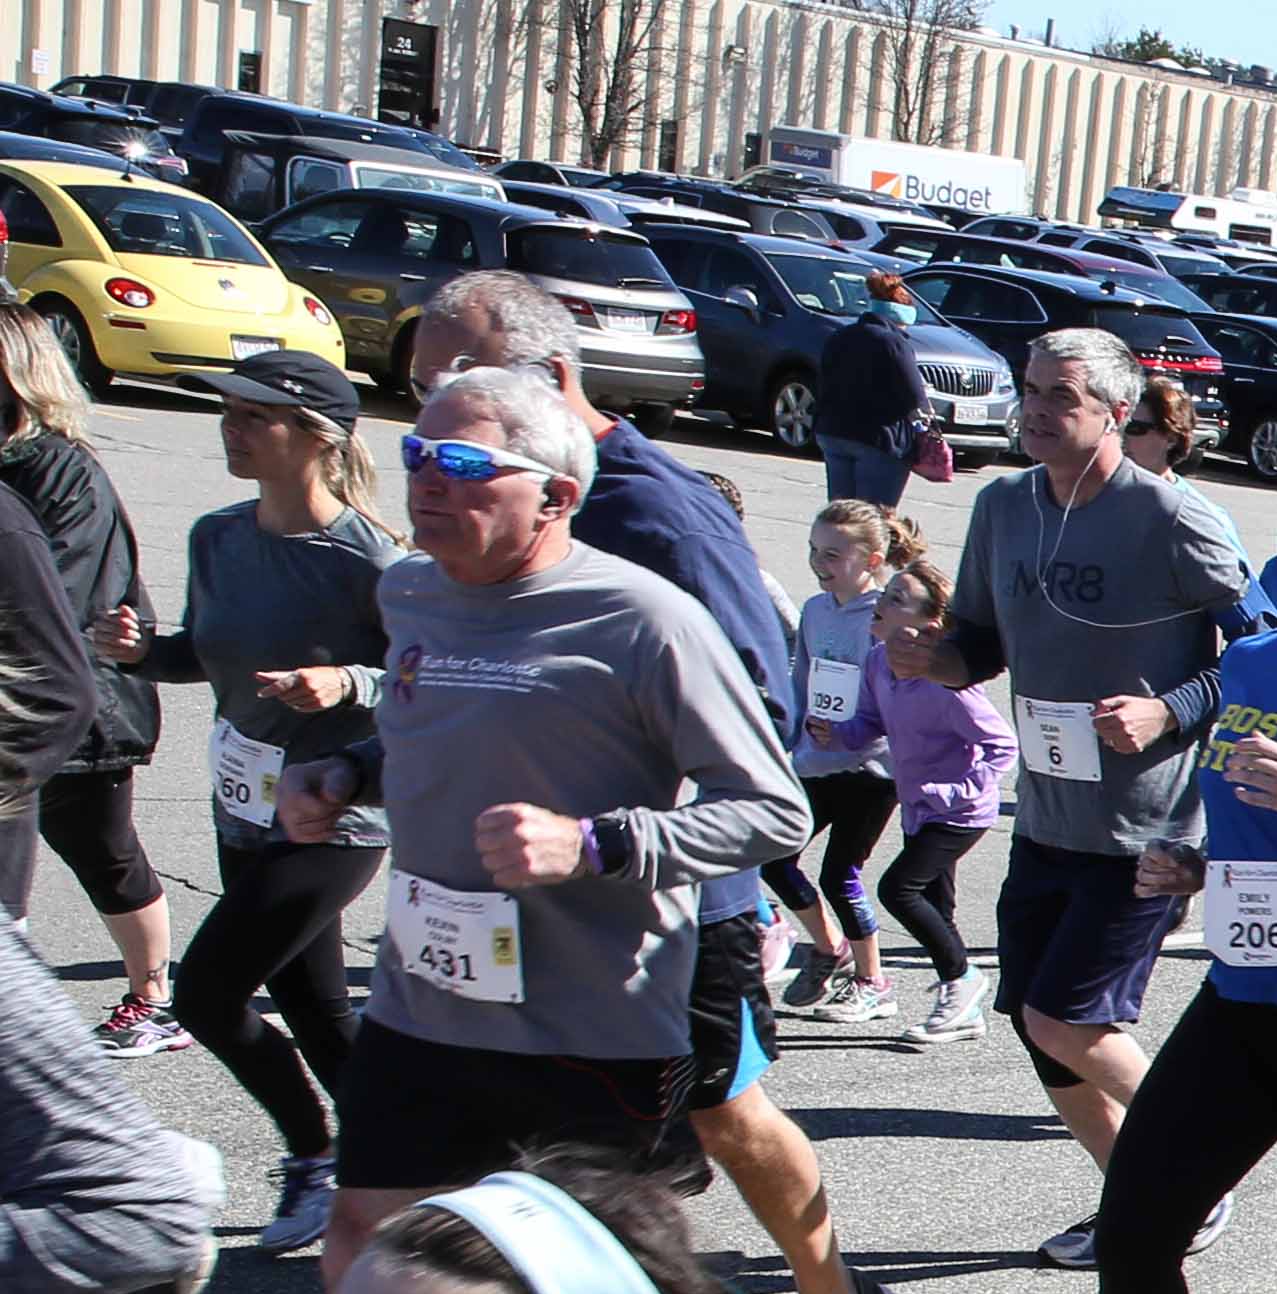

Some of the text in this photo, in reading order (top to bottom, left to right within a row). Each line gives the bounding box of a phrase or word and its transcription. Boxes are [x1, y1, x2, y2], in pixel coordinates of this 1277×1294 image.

[396, 35, 412, 50] 24
[905, 174, 993, 210] Budget
[1008, 560, 1105, 604] MR8
[1049, 745, 1063, 765] 6
[215, 769, 251, 804] 60
[1238, 892, 1270, 903] EMILY
[420, 944, 477, 981] 431
